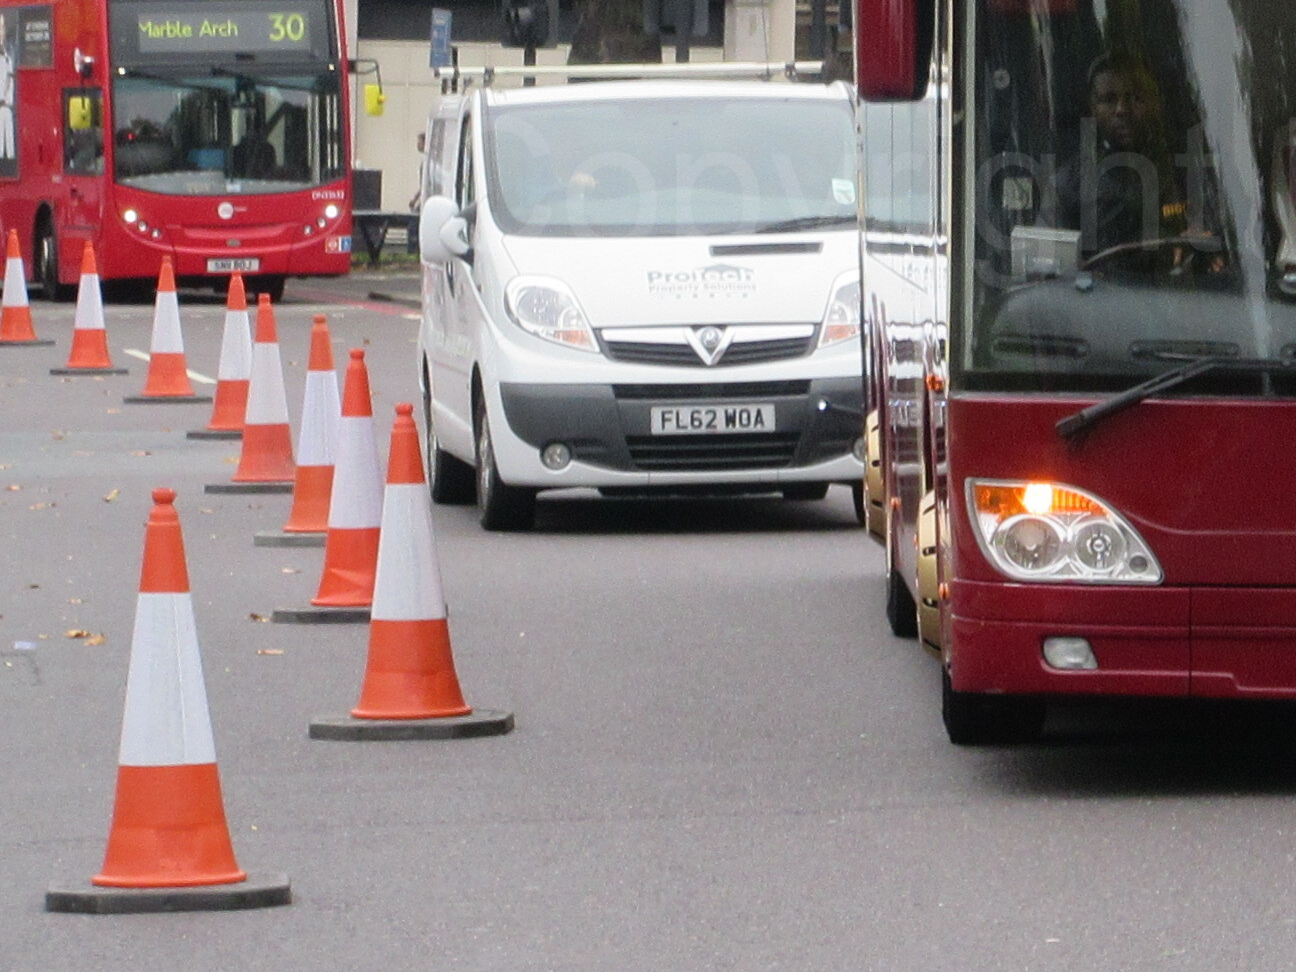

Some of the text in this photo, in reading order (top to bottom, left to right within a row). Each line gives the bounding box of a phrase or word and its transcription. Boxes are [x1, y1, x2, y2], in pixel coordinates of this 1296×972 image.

[139, 19, 239, 39] Marble Arch
[268, 13, 304, 41] 30
[661, 408, 765, 431] FL62 WOA
